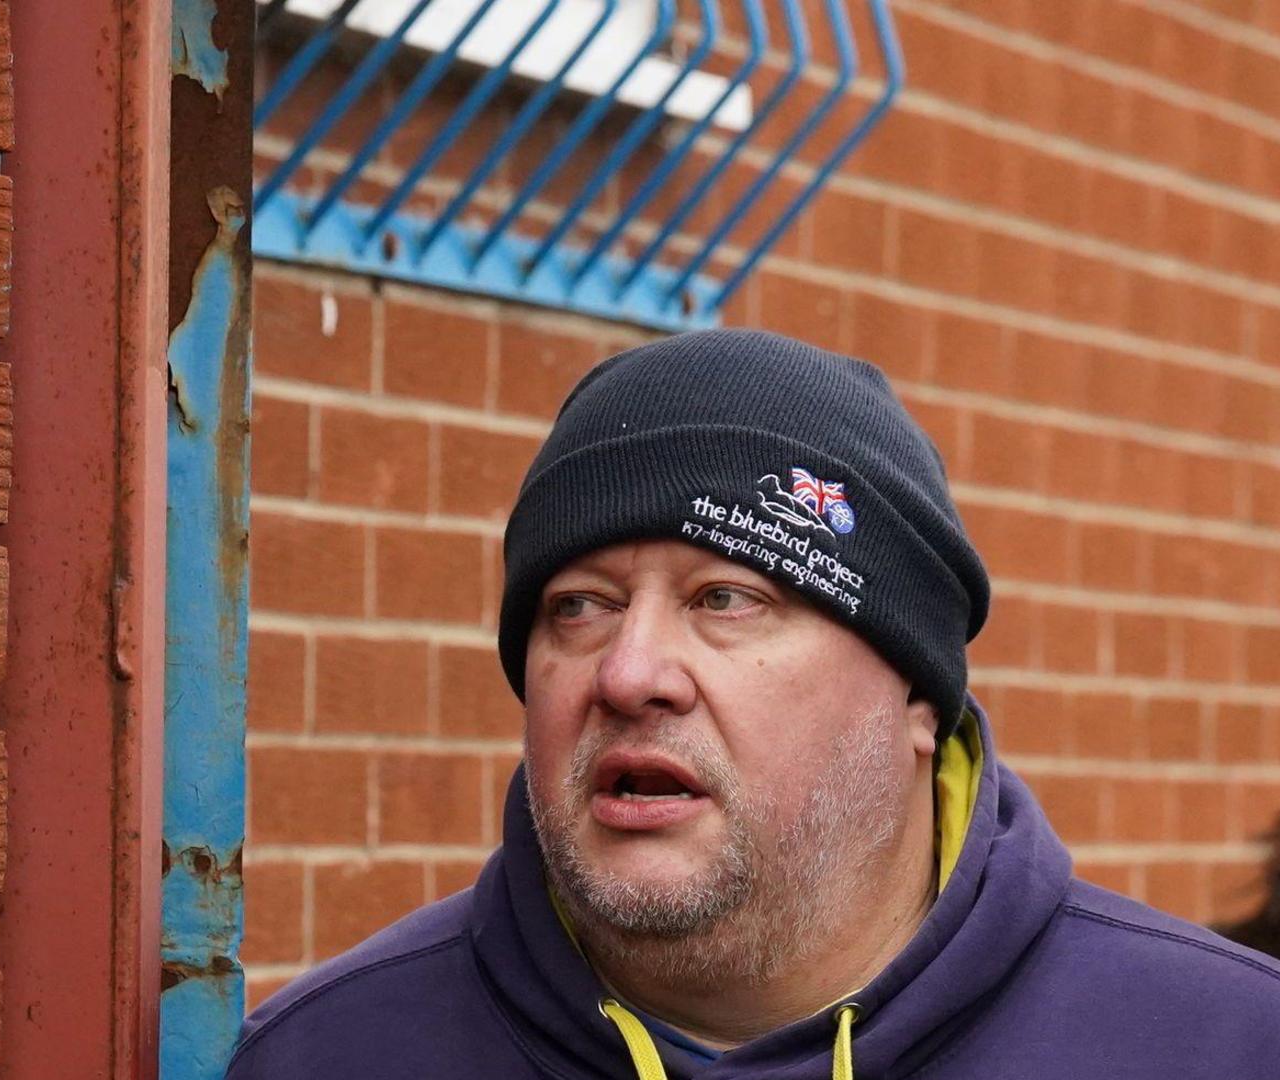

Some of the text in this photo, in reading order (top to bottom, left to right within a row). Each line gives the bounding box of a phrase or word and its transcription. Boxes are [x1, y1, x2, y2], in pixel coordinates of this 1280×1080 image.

[682, 521, 862, 615] K7-inspiring engineering
[692, 496, 865, 589] the bluebird project
